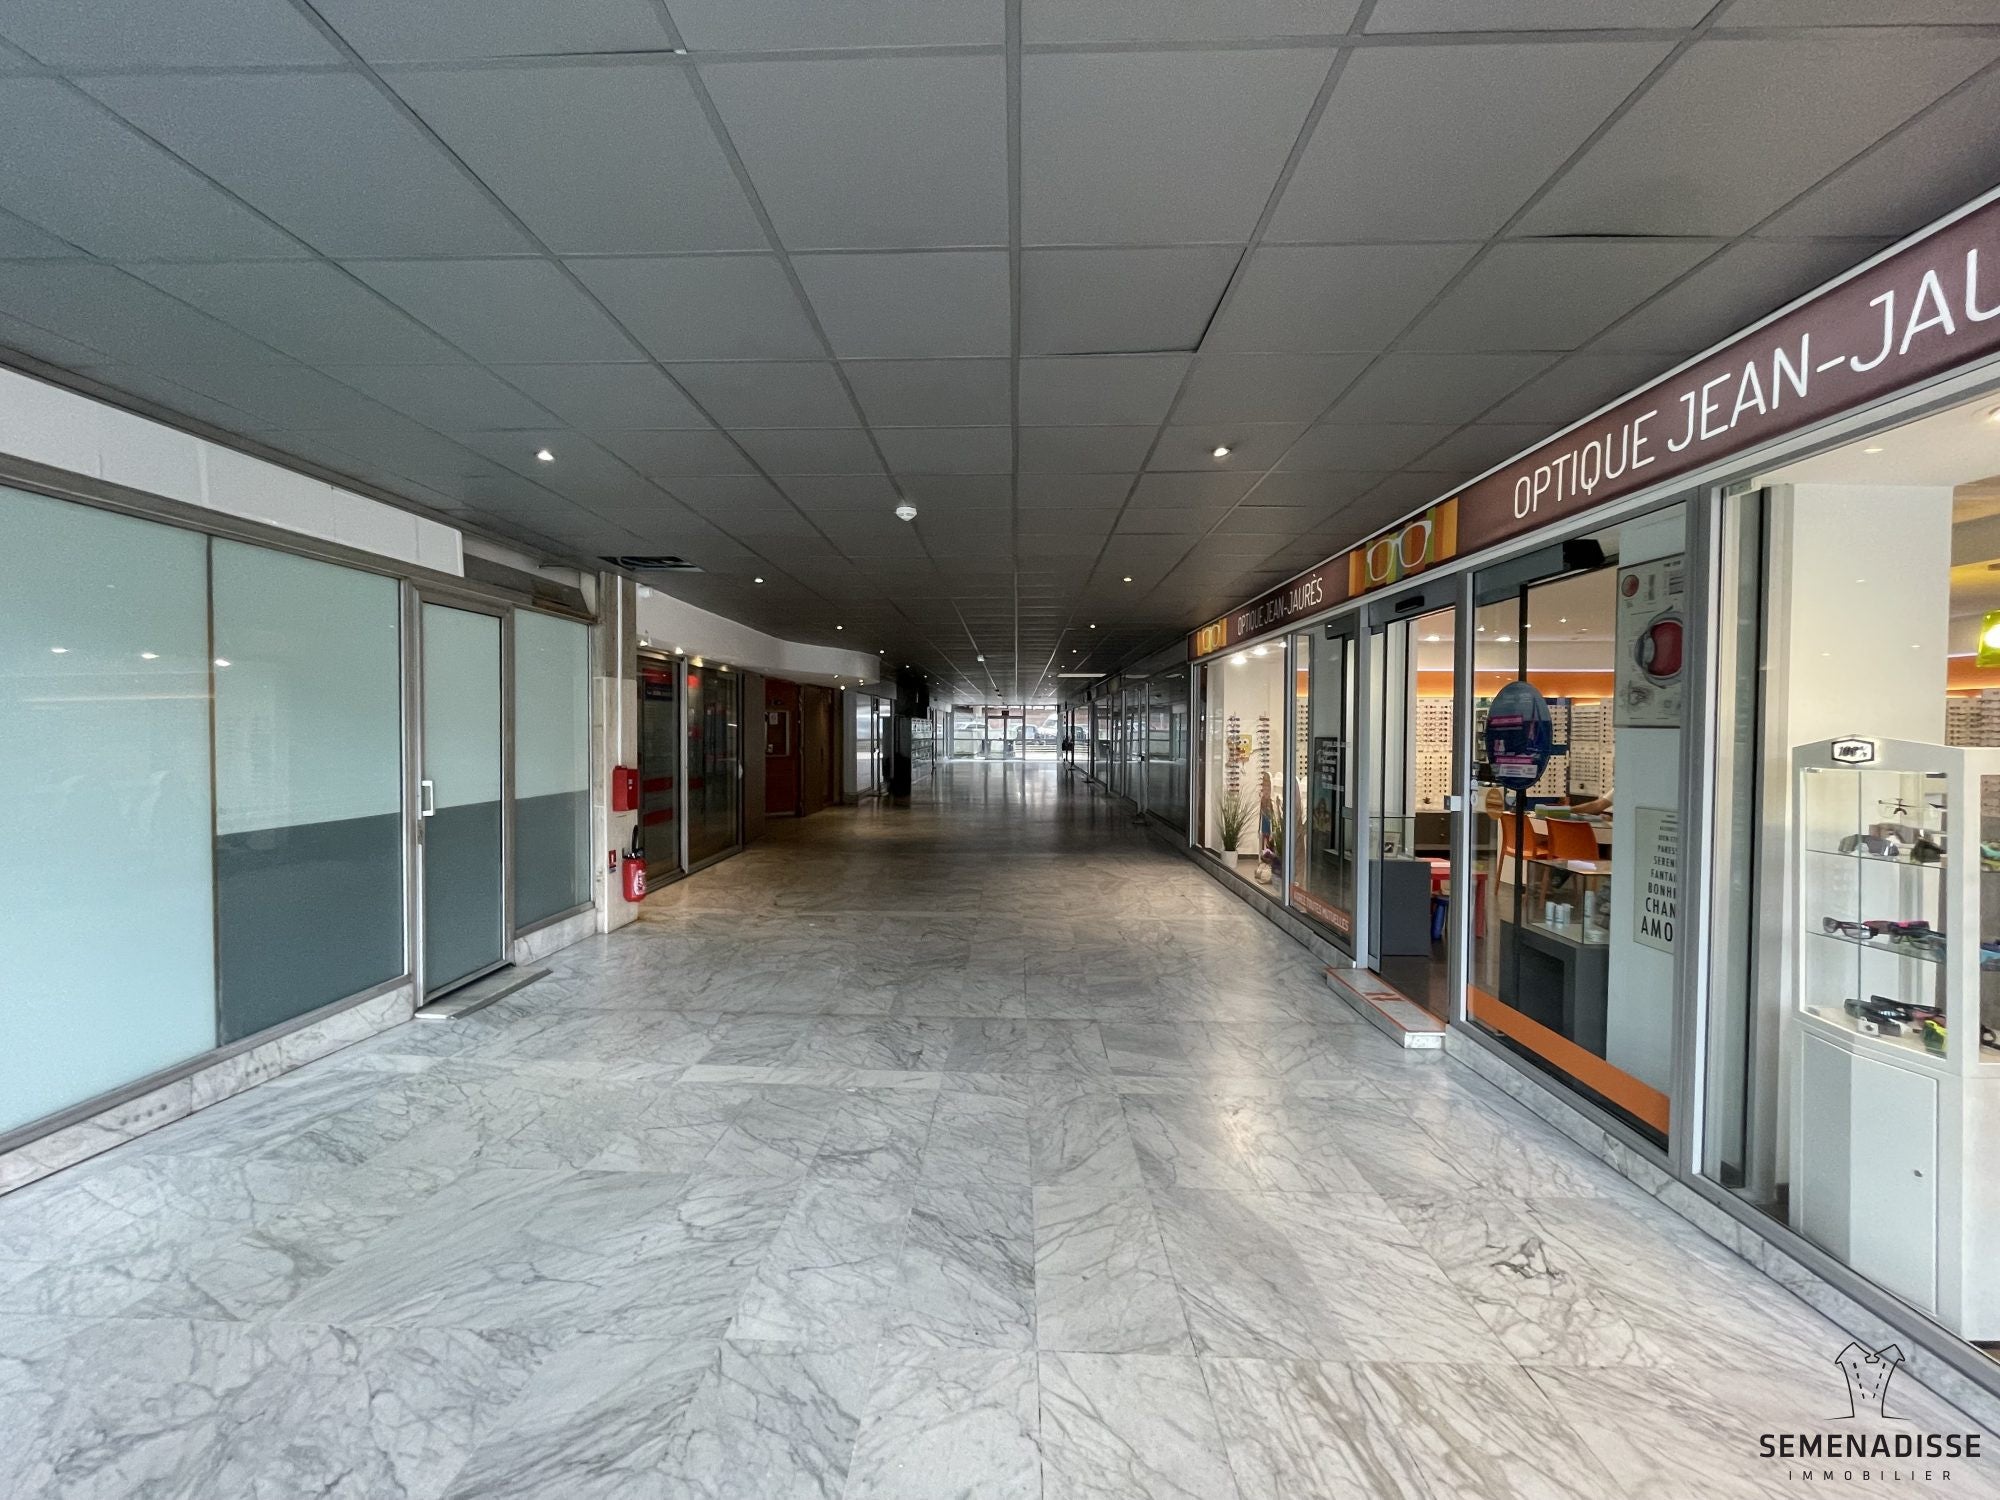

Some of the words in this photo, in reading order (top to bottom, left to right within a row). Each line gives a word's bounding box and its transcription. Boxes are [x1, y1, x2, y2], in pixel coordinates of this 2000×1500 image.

[1514, 409, 1658, 519] OPTIQUE
[1667, 248, 2000, 452] JEAN-JAU
[1237, 605, 1264, 636] OPTIQUE
[1264, 573, 1323, 625] JEAN-JAURÈS
[1641, 915, 1673, 942] AMO
[1645, 897, 1676, 918] CHAN
